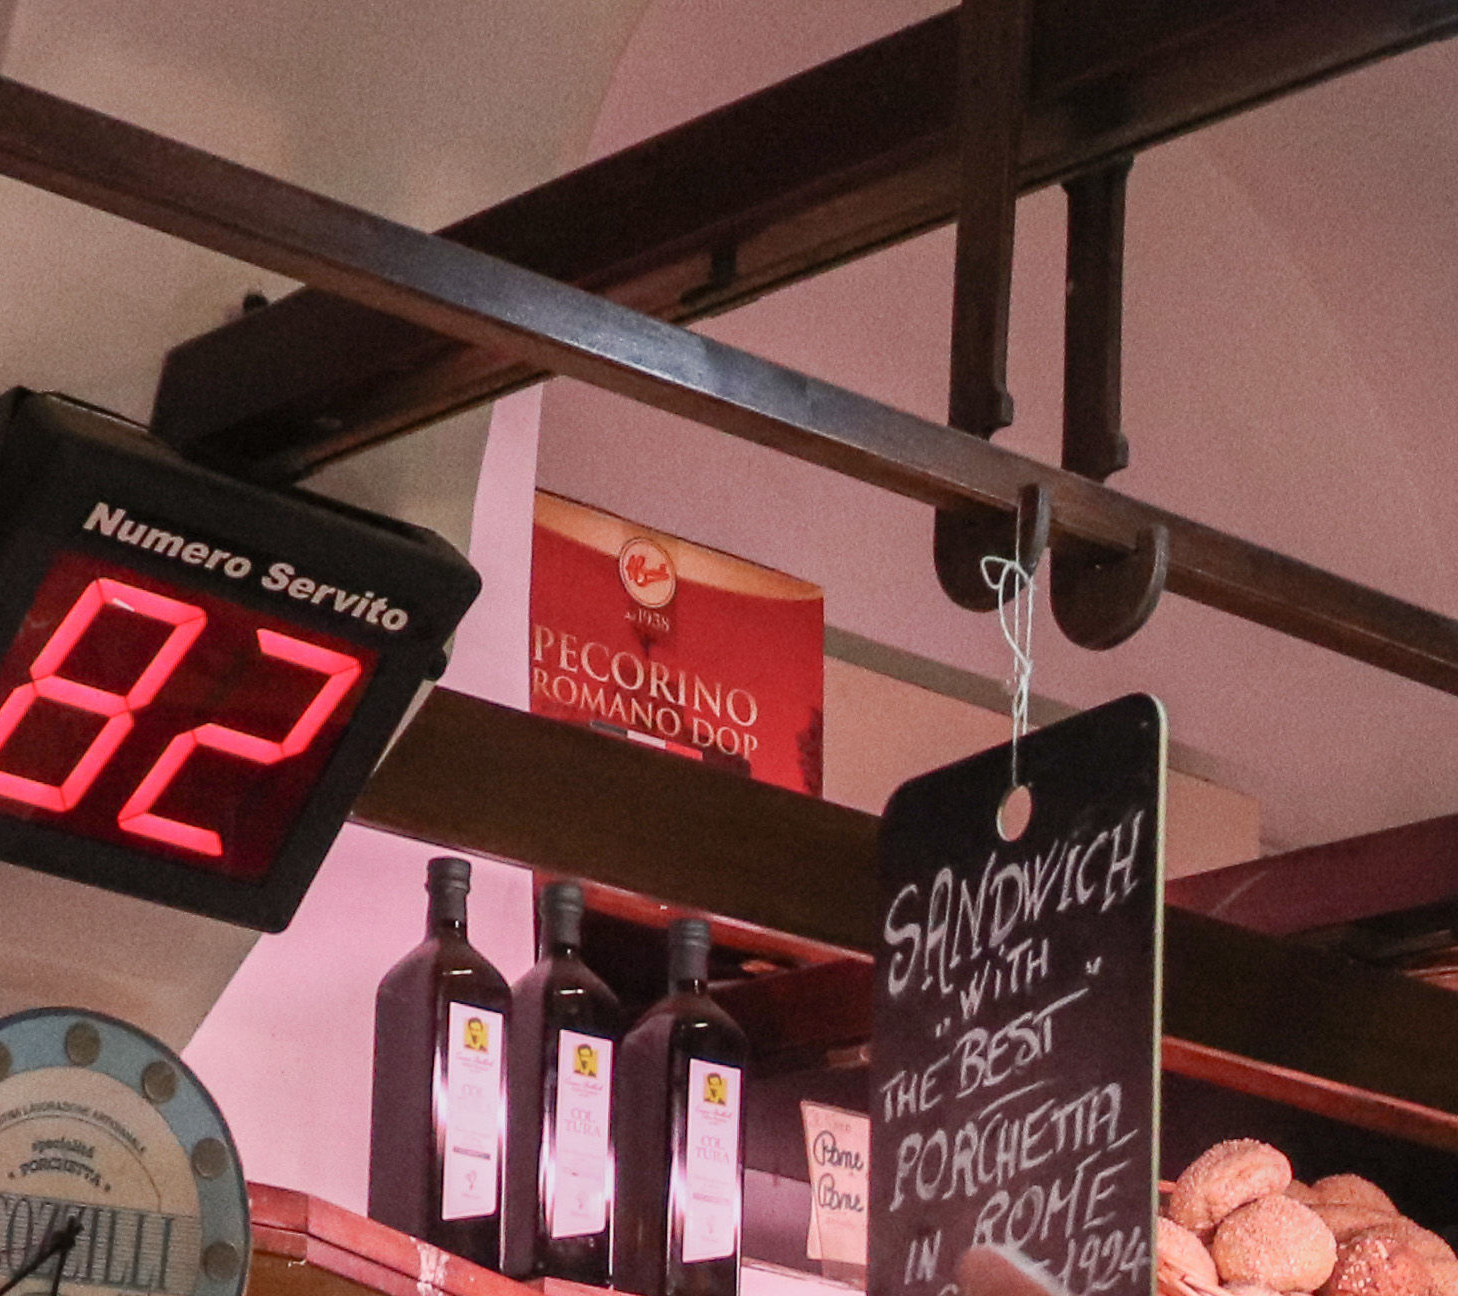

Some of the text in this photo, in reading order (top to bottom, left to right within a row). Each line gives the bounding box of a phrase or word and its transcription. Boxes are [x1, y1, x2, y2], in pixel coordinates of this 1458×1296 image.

[83, 502, 410, 633] Numero Servito
[637, 609, 670, 634] 1938
[533, 624, 758, 727] PECORINO
[533, 666, 759, 760] ROMANO DOP
[884, 809, 1144, 997] SANDWICH
[880, 1055, 950, 1122] THE
[890, 1082, 1122, 1211] PORCHETTA
[905, 1151, 1131, 1285] IN ROME
